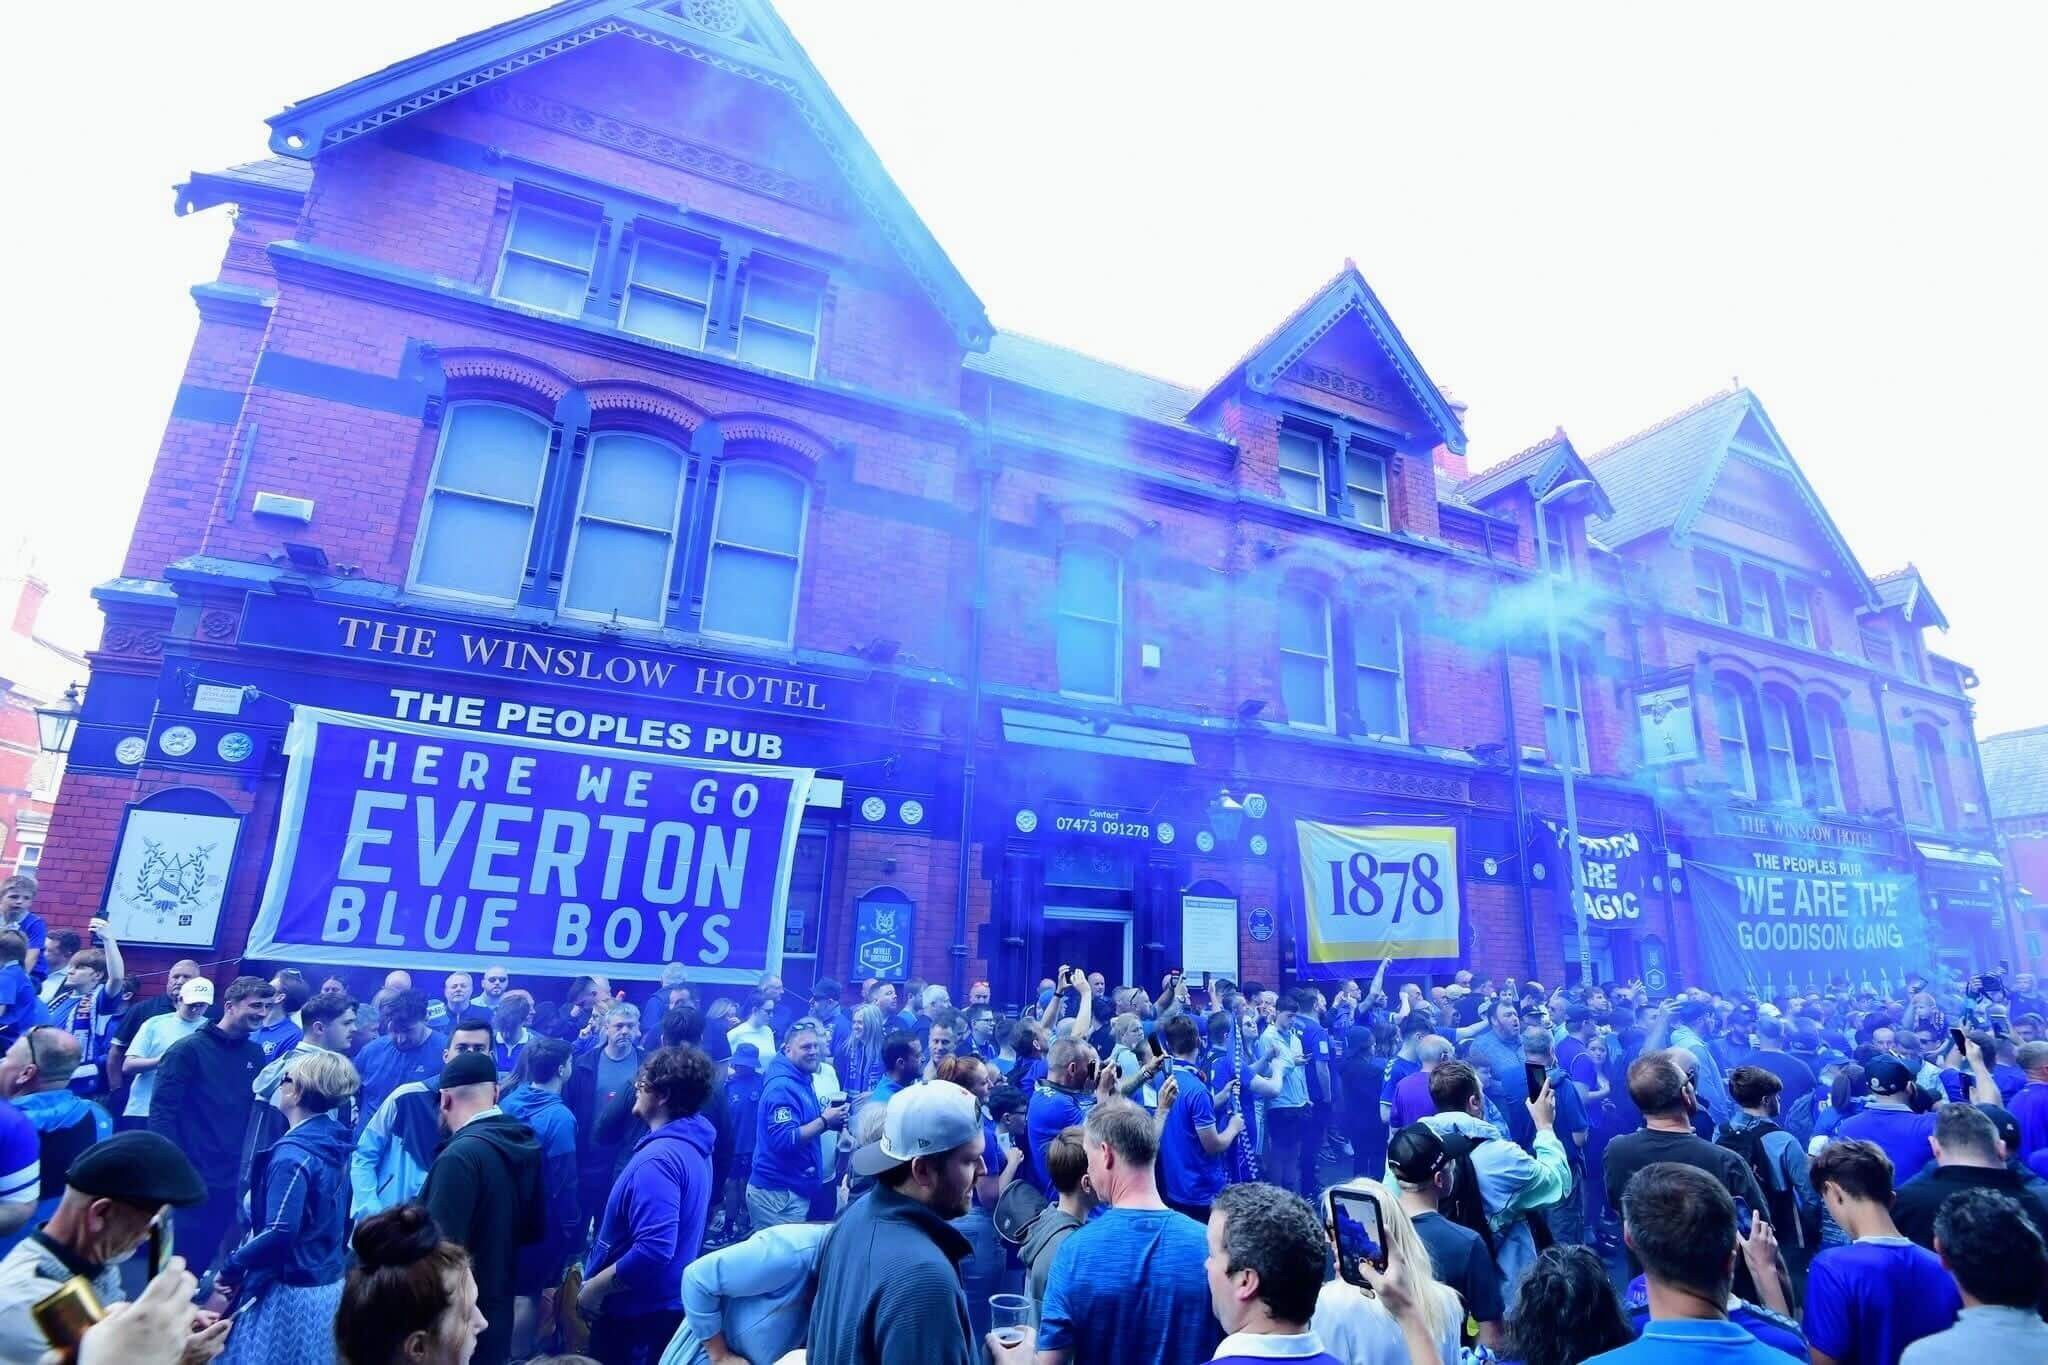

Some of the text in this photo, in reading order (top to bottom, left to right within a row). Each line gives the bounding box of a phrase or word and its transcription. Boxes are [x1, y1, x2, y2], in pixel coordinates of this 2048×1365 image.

[338, 615, 826, 711] THE WINSLOW HOTEL
[390, 689, 783, 760] THE PEOPLES PUB
[363, 738, 760, 818] HERE WE GO
[1056, 816, 1150, 838] 07473 091278
[1088, 808, 1120, 820] Contact
[1737, 815, 1873, 848] THE WINSLOW HOTEL
[337, 789, 752, 910] EVERTON
[1753, 852, 1780, 871] THE
[1783, 855, 1836, 875] PEOPLES
[1326, 851, 1444, 923] 1878
[1571, 890, 1640, 921] AGIC
[1735, 875, 1900, 918] WE ARE THE
[321, 886, 732, 965] BLUE BOYS
[1737, 920, 1904, 951] GOODISON GANG
